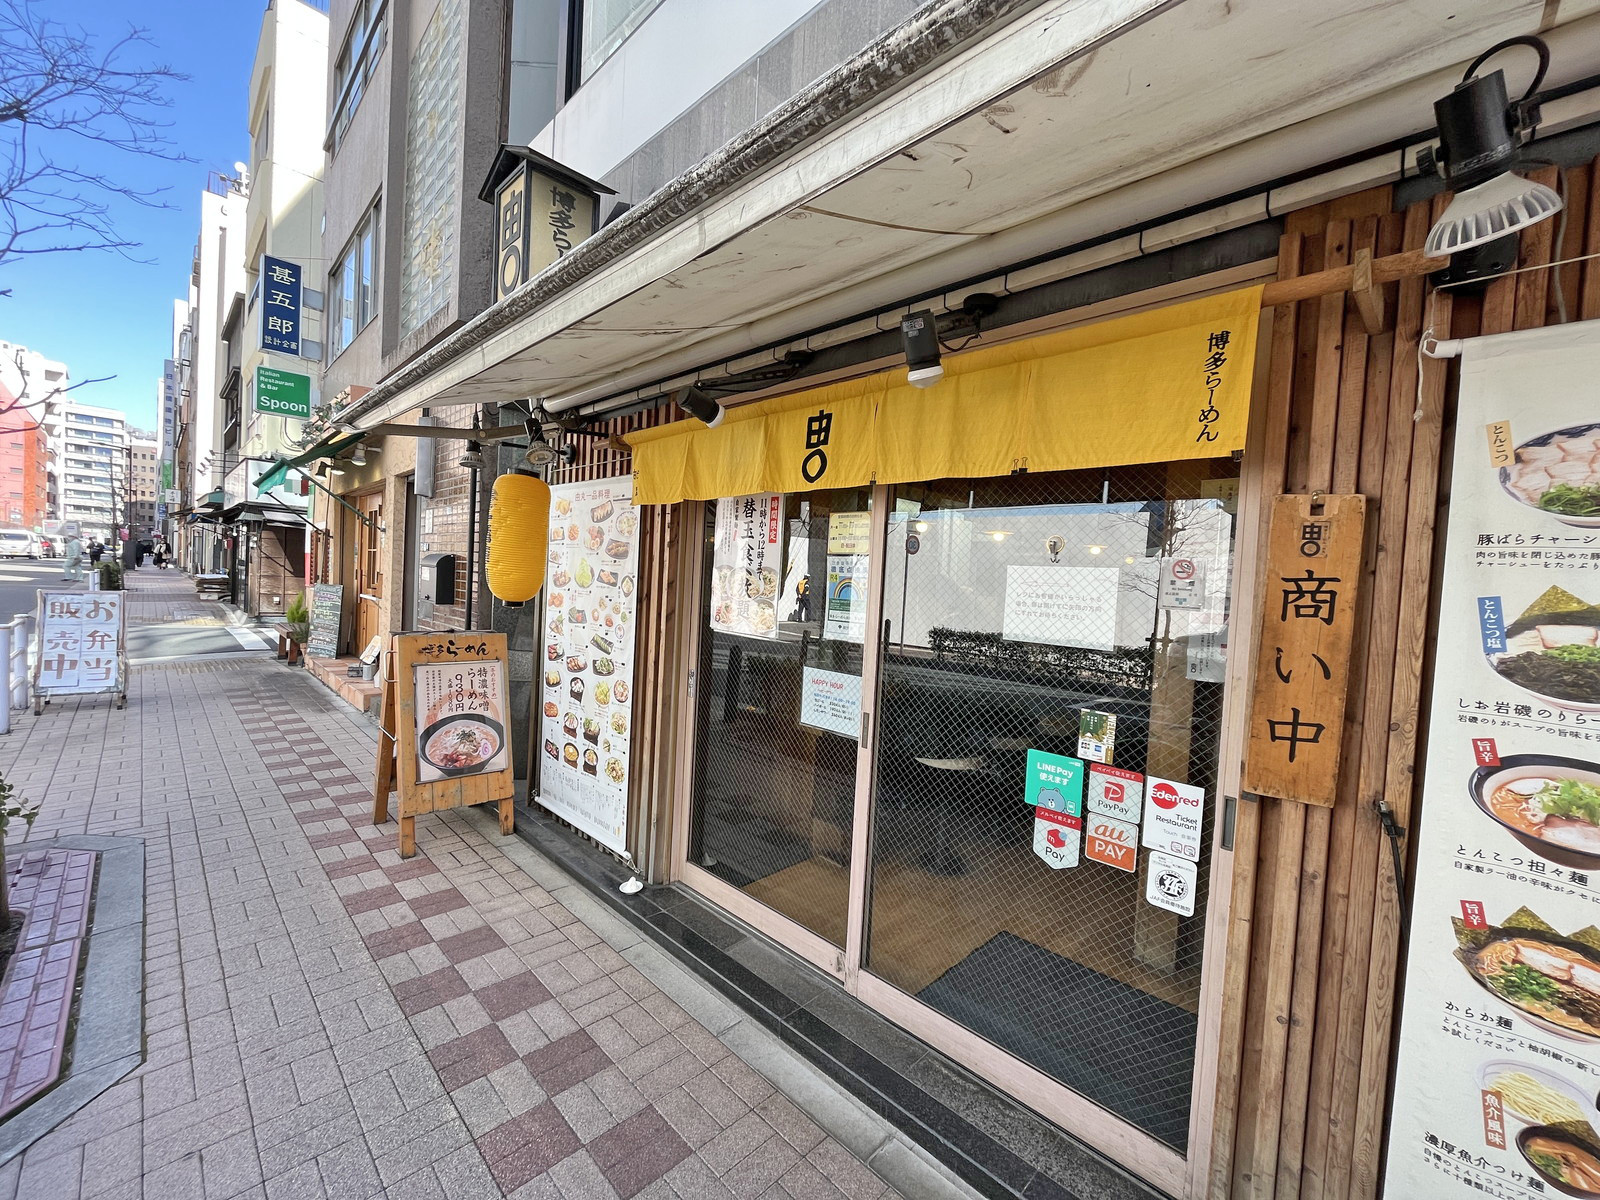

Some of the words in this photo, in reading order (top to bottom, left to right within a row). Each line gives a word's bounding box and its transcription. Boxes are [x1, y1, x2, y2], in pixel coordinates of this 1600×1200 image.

[267, 265, 296, 335] 甚五郎
[264, 335, 298, 350] 設計企画
[259, 369, 280, 378] Italian
[259, 376, 295, 388] Restaurant
[1196, 330, 1231, 443] 博多らーめん
[260, 395, 307, 413] Spoon
[1491, 424, 1509, 463] とんこつ
[1476, 533, 1598, 546] 豚ばらチャーシ
[1483, 599, 1503, 649] とんこつ塩
[43, 601, 81, 680] 販売中
[83, 599, 117, 681] お弁当
[1266, 568, 1342, 764] 商い中
[454, 673, 465, 712] 930円
[467, 667, 478, 711] らーめん
[477, 666, 490, 712] 特濃味噌
[811, 678, 829, 687] HAPPY
[829, 681, 844, 690] HOUR
[1105, 715, 1117, 750] WELCOME
[1036, 761, 1056, 773] LINE
[1056, 767, 1074, 778] Pay
[1039, 772, 1069, 786] 使えます
[1097, 800, 1130, 815] PayPay
[1151, 788, 1200, 807] Edenred
[1155, 814, 1198, 832] Restaurant
[1175, 813, 1198, 825] Ticket
[1094, 824, 1130, 843] au
[1045, 846, 1065, 862] Pay
[1095, 840, 1127, 860] PAY
[1456, 844, 1589, 886] とんこつ担々麺
[1444, 1001, 1513, 1031] からか麺
[1441, 1025, 1516, 1053] お試しください
[1484, 1094, 1504, 1146] 魚介風味
[1424, 1131, 1545, 1193] 濃厚魚介つけ麺
